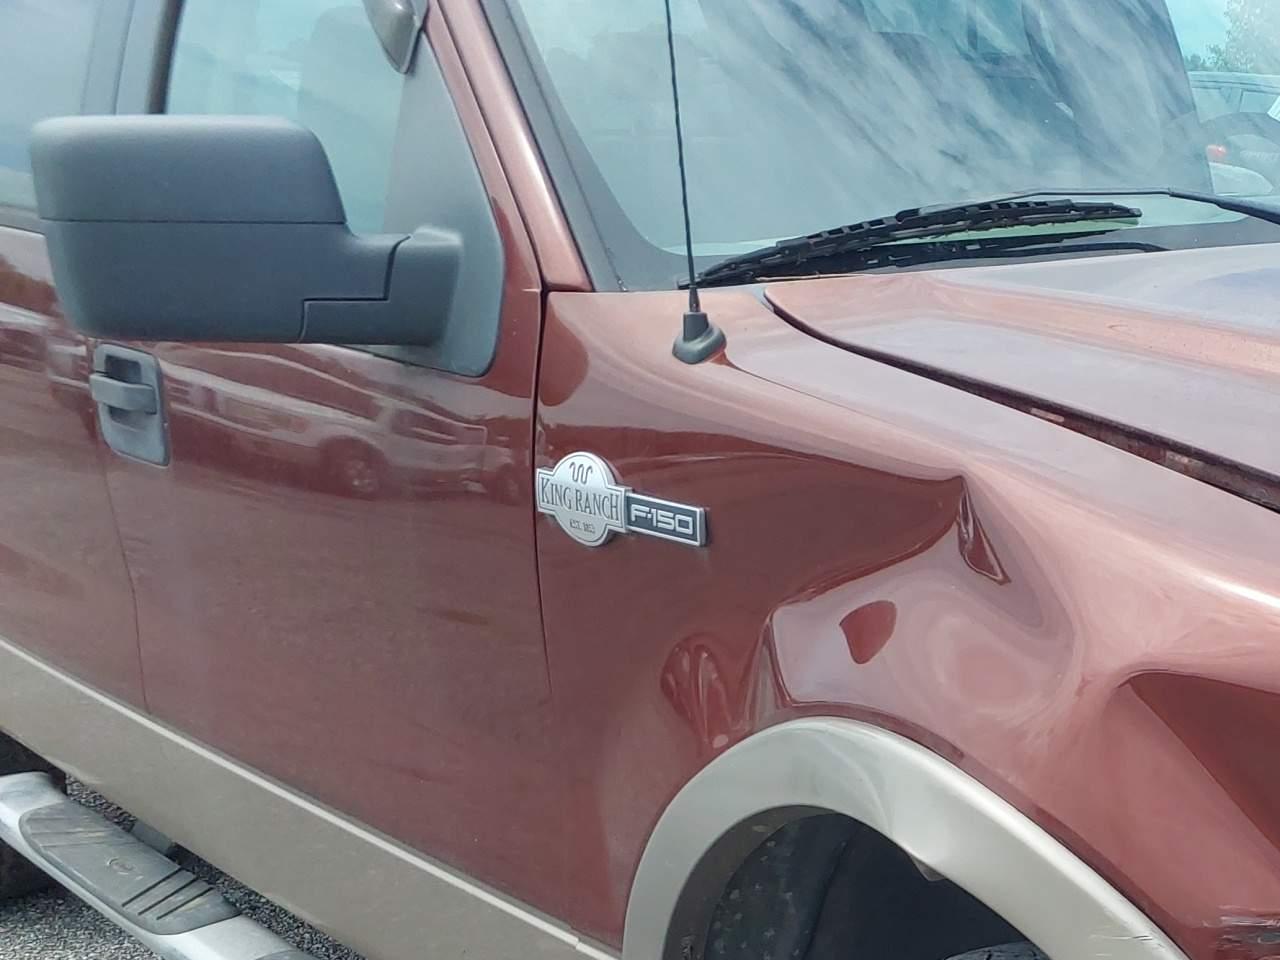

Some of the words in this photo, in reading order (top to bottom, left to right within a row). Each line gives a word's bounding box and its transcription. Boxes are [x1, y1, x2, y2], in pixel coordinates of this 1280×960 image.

[541, 477, 572, 511] KING
[575, 487, 619, 521] RANCH
[631, 503, 694, 535] F-150
